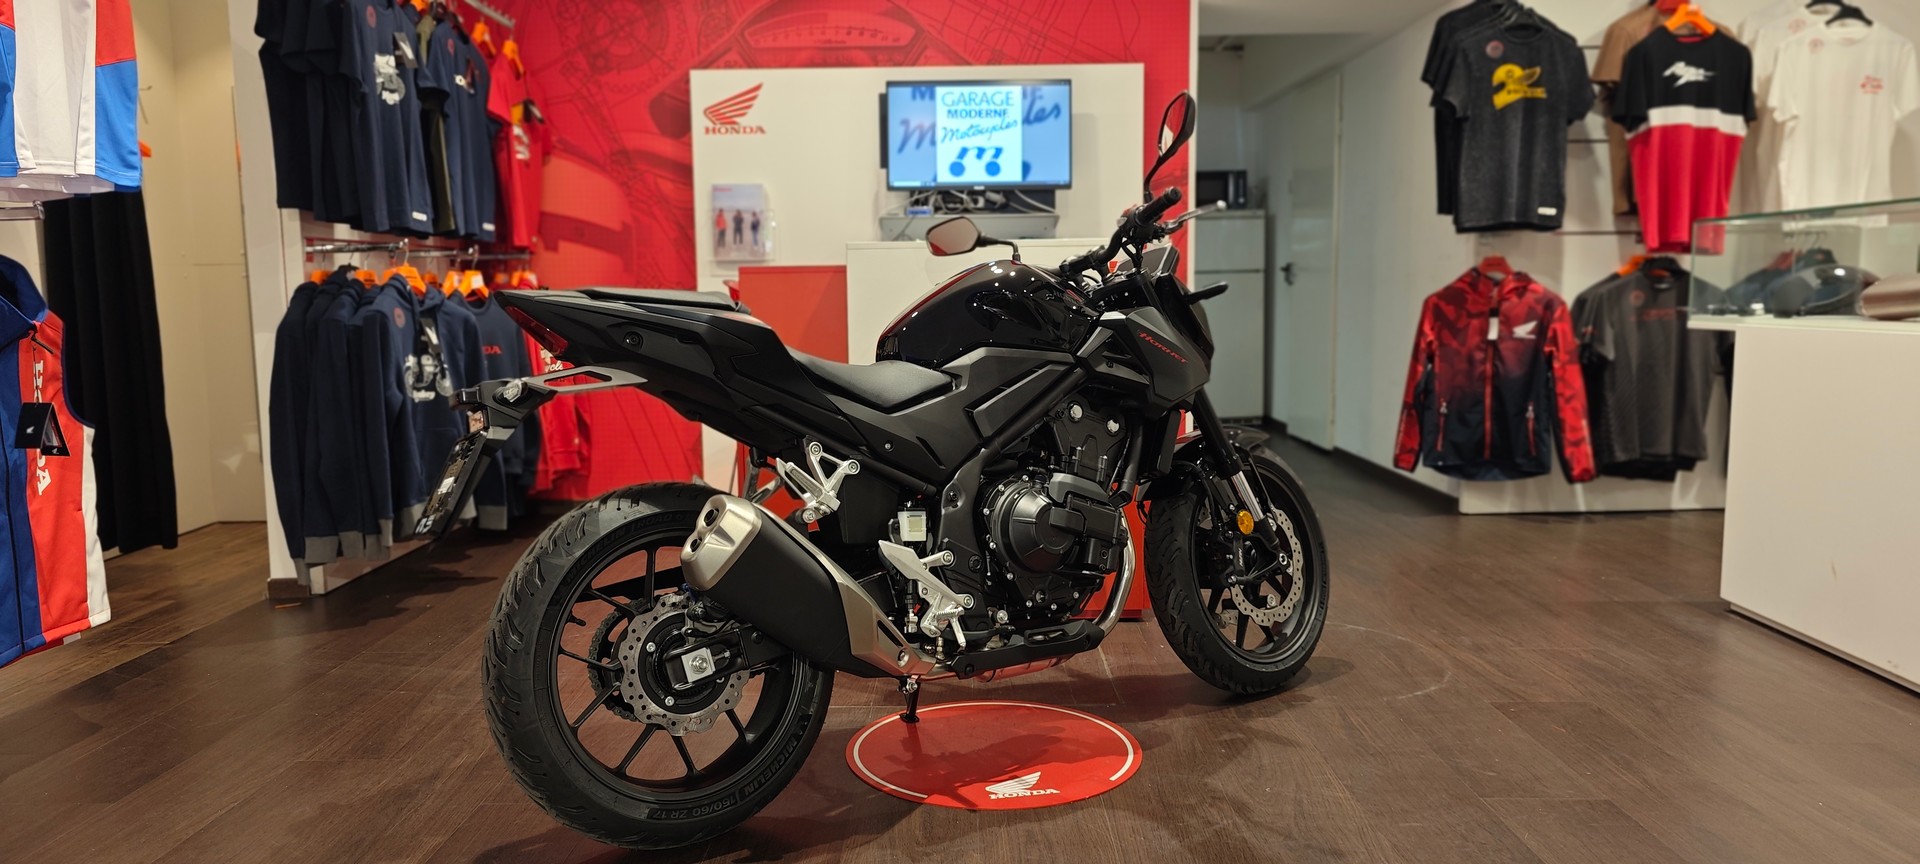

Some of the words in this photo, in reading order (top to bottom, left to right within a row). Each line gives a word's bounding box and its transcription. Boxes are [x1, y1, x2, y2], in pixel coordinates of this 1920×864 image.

[941, 91, 1015, 107] GARAGE
[946, 108, 1010, 119] MODERNE
[704, 125, 767, 135] HONDA
[940, 116, 1019, 143] Motocycles
[743, 737, 798, 796] MICHELIN
[988, 788, 1061, 800] HONDA
[652, 809, 667, 819] 17
[671, 809, 688, 819] ZR
